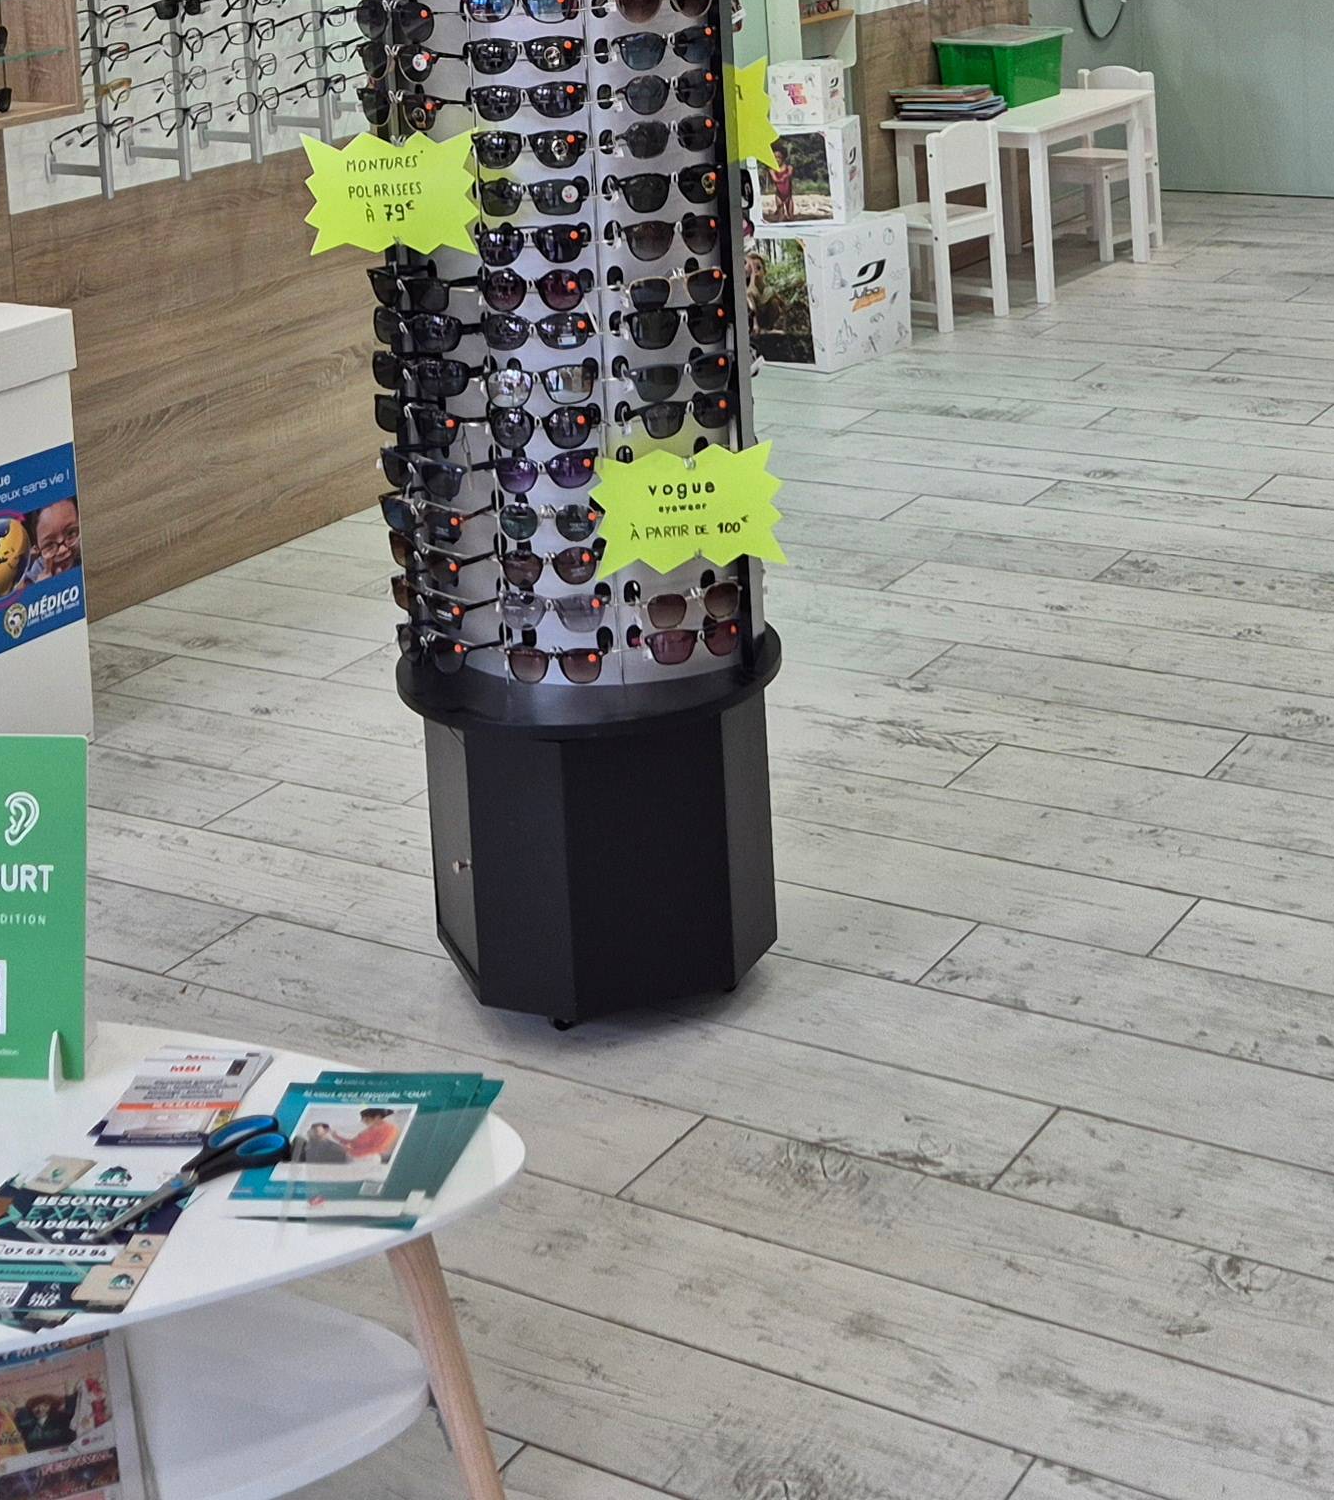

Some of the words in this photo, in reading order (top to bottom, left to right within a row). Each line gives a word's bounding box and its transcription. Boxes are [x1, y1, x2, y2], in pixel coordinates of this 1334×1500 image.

[346, 155, 418, 173] MONTURES
[22, 479, 48, 495] sans
[49, 472, 65, 486] vie
[648, 481, 716, 499] vogue
[658, 503, 707, 514] eyewear
[630, 523, 640, 541] À
[646, 525, 690, 540] PARTIR
[695, 524, 709, 535] DE
[28, 585, 80, 619] MÉDICO
[33, 1195, 110, 1207] BESOIN
[16, 1220, 40, 1229] DU
